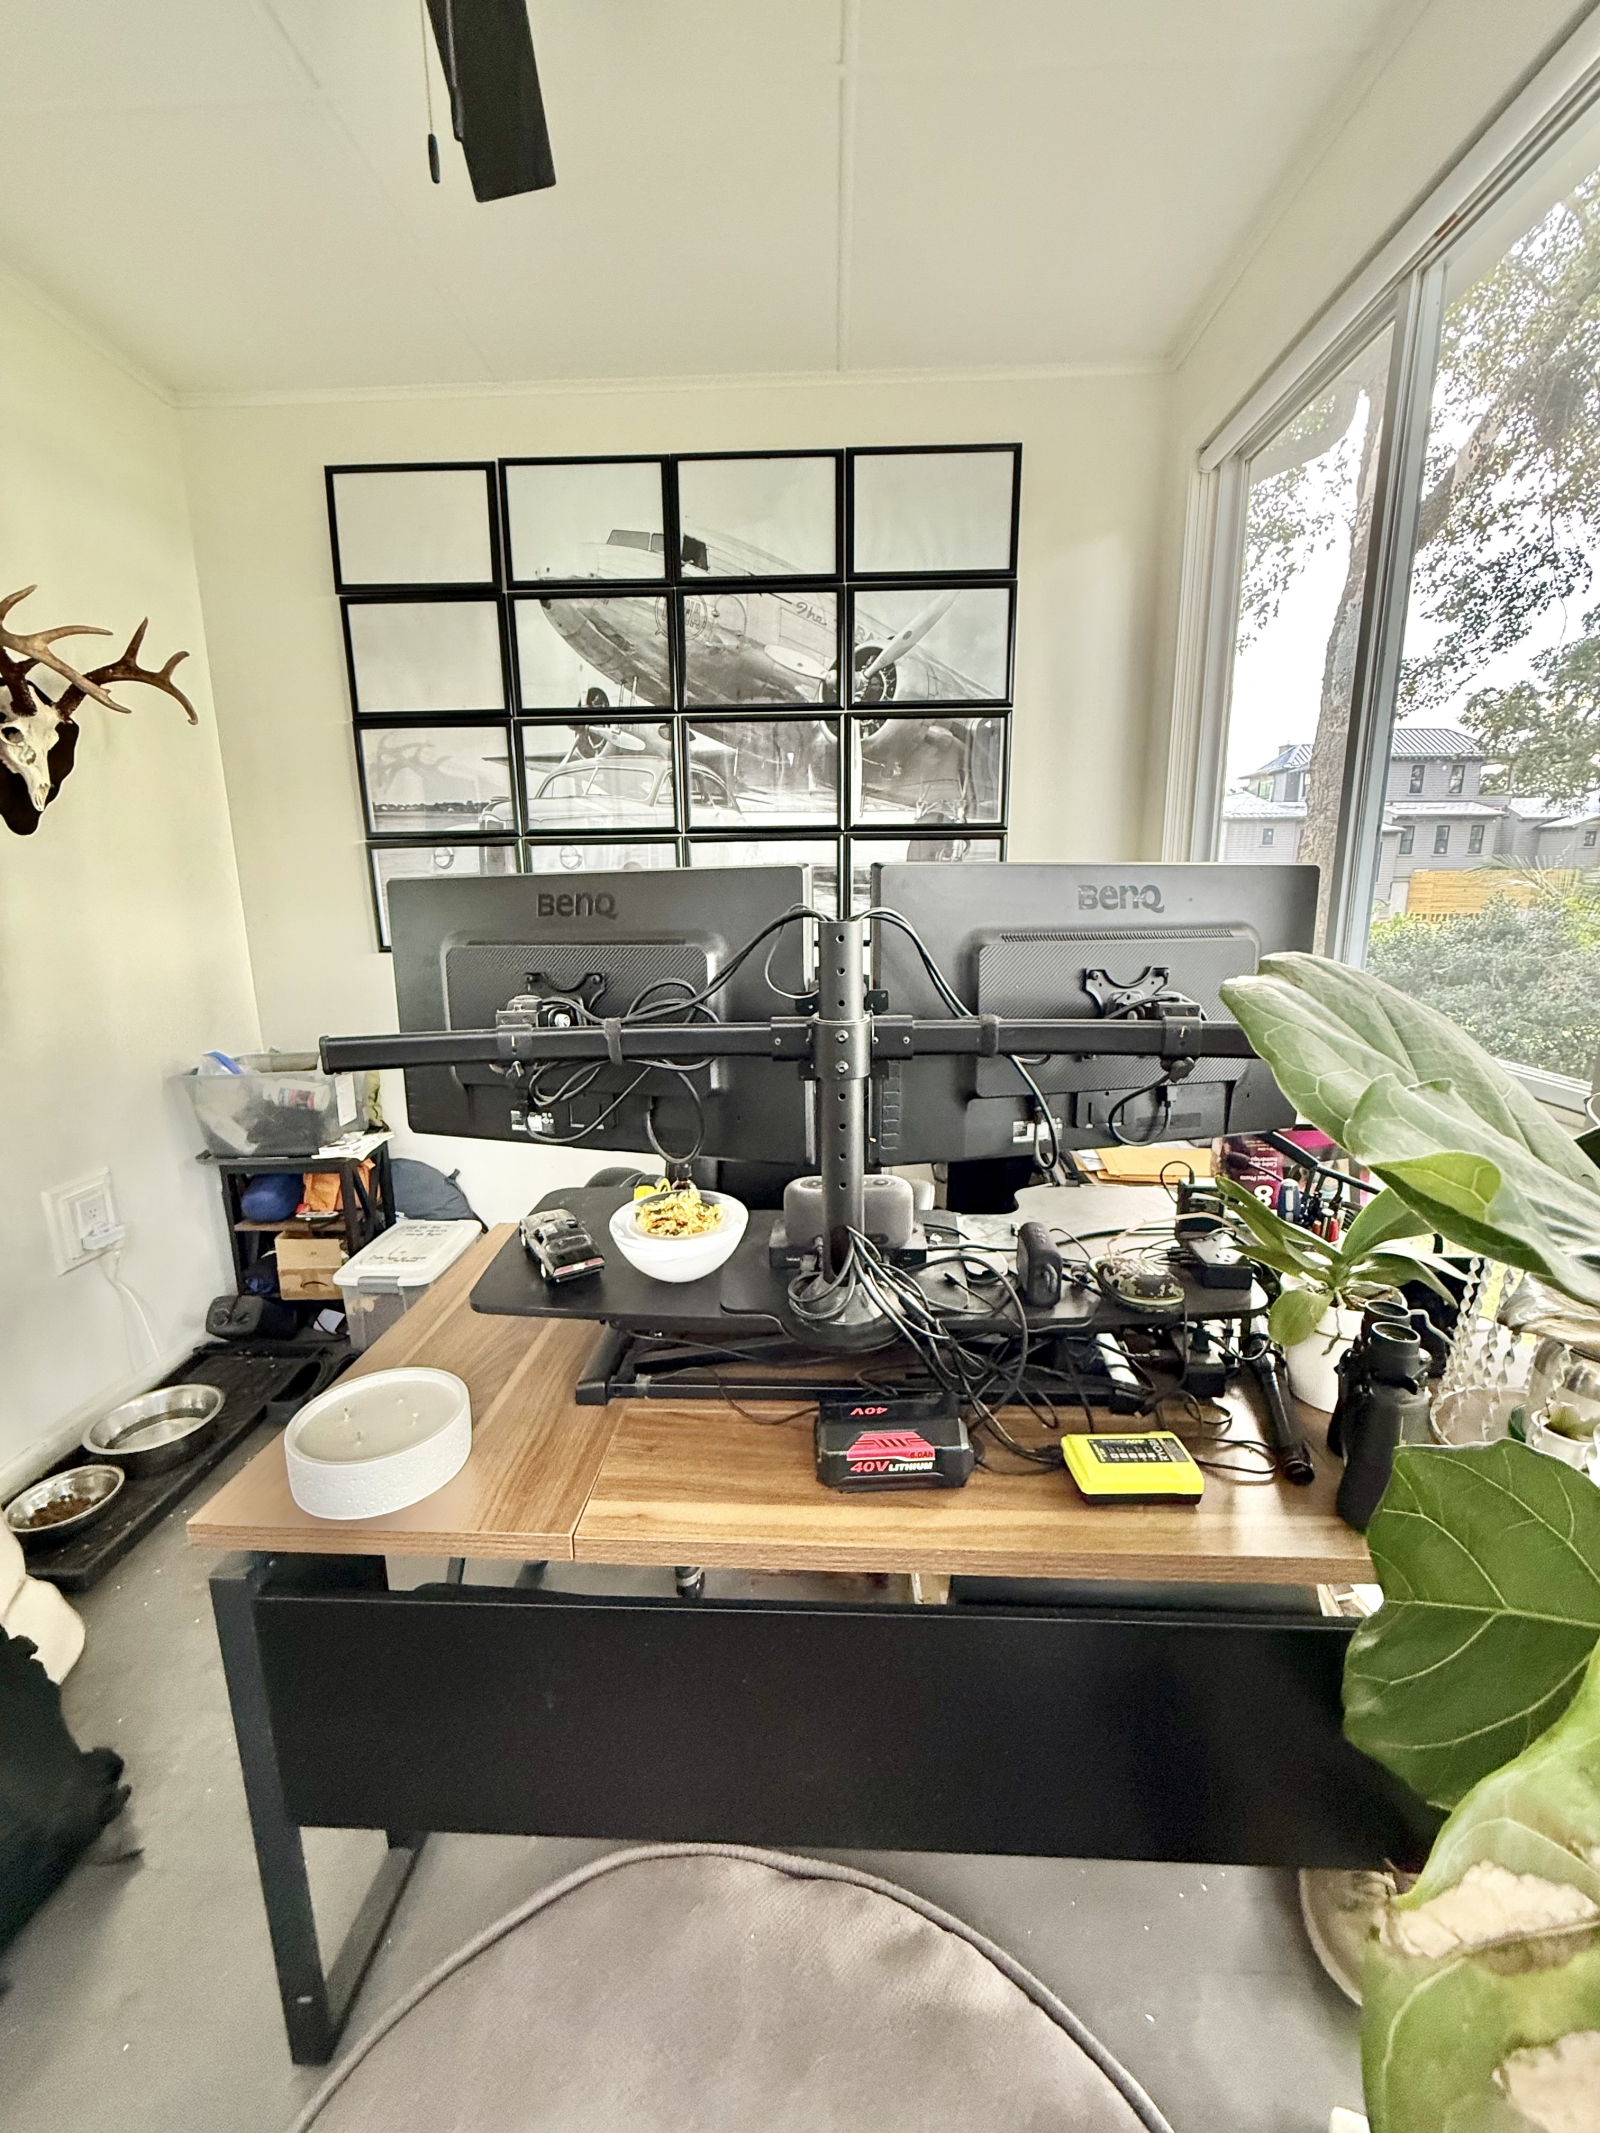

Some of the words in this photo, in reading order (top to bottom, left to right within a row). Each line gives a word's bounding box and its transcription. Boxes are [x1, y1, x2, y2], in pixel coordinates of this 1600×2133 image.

[537, 892, 618, 920] BenQ
[1077, 884, 1165, 914] BenQ
[1254, 1185, 1274, 1207] 8
[850, 1406, 889, 1416] 40V
[850, 1460, 890, 1473] 40V
[888, 1461, 934, 1472] LITHIUM
